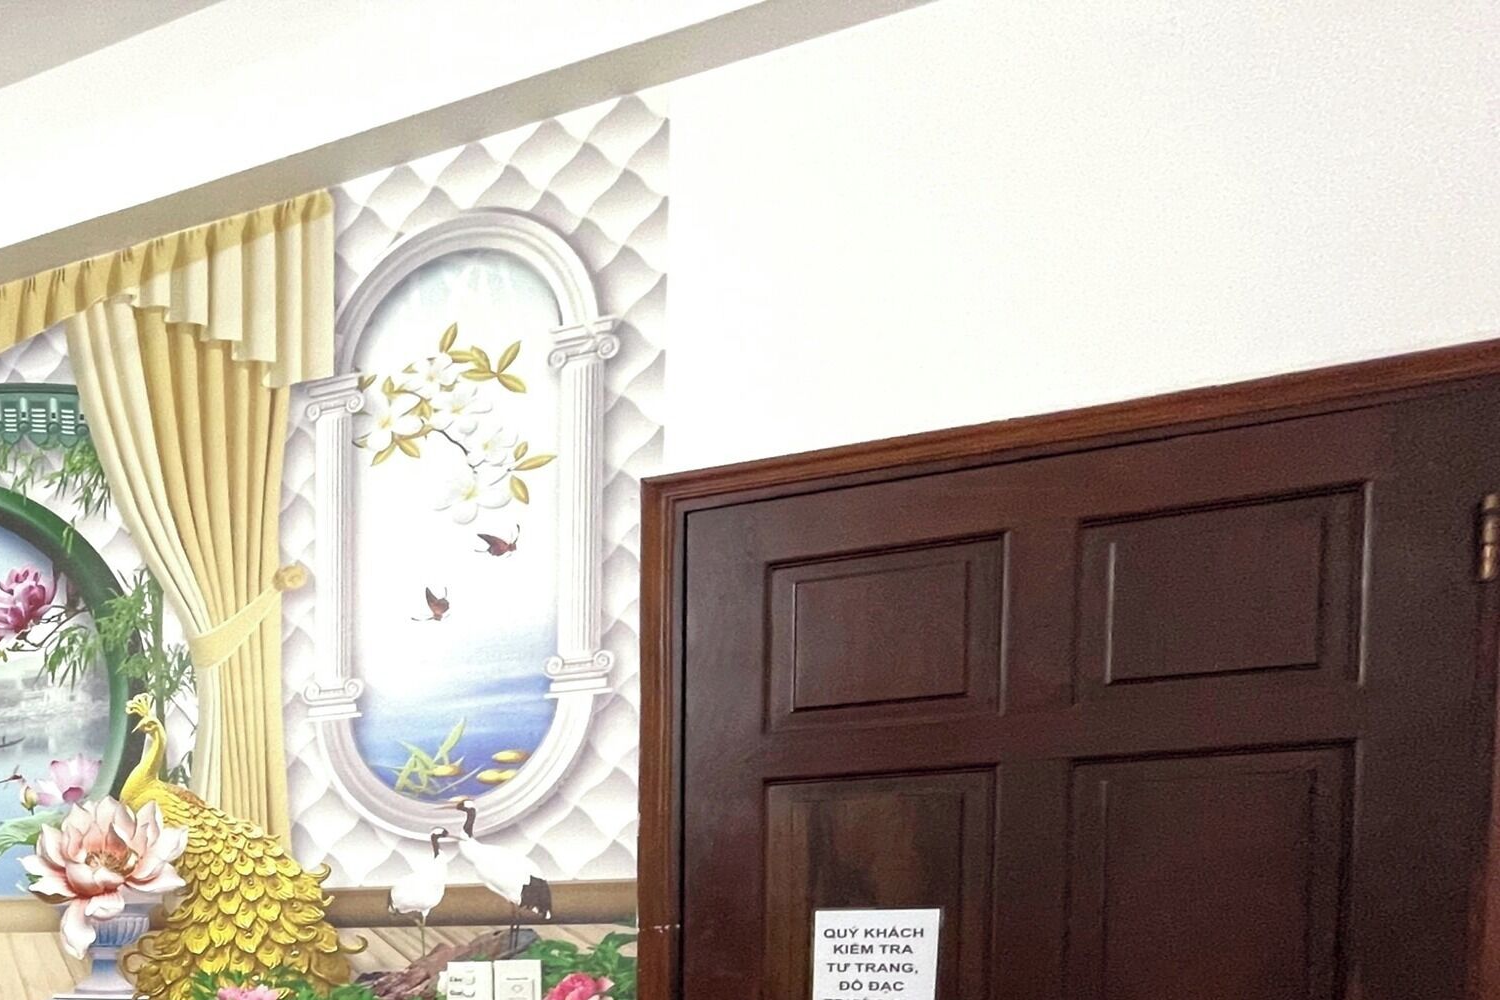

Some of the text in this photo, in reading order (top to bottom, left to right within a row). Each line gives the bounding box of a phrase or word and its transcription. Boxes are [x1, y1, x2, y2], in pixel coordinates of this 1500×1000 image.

[864, 926, 925, 939] KHÁCH
[879, 944, 914, 955] TRA
[827, 963, 919, 975] TƯ TRANG,
[868, 981, 905, 994] ĐẠC
